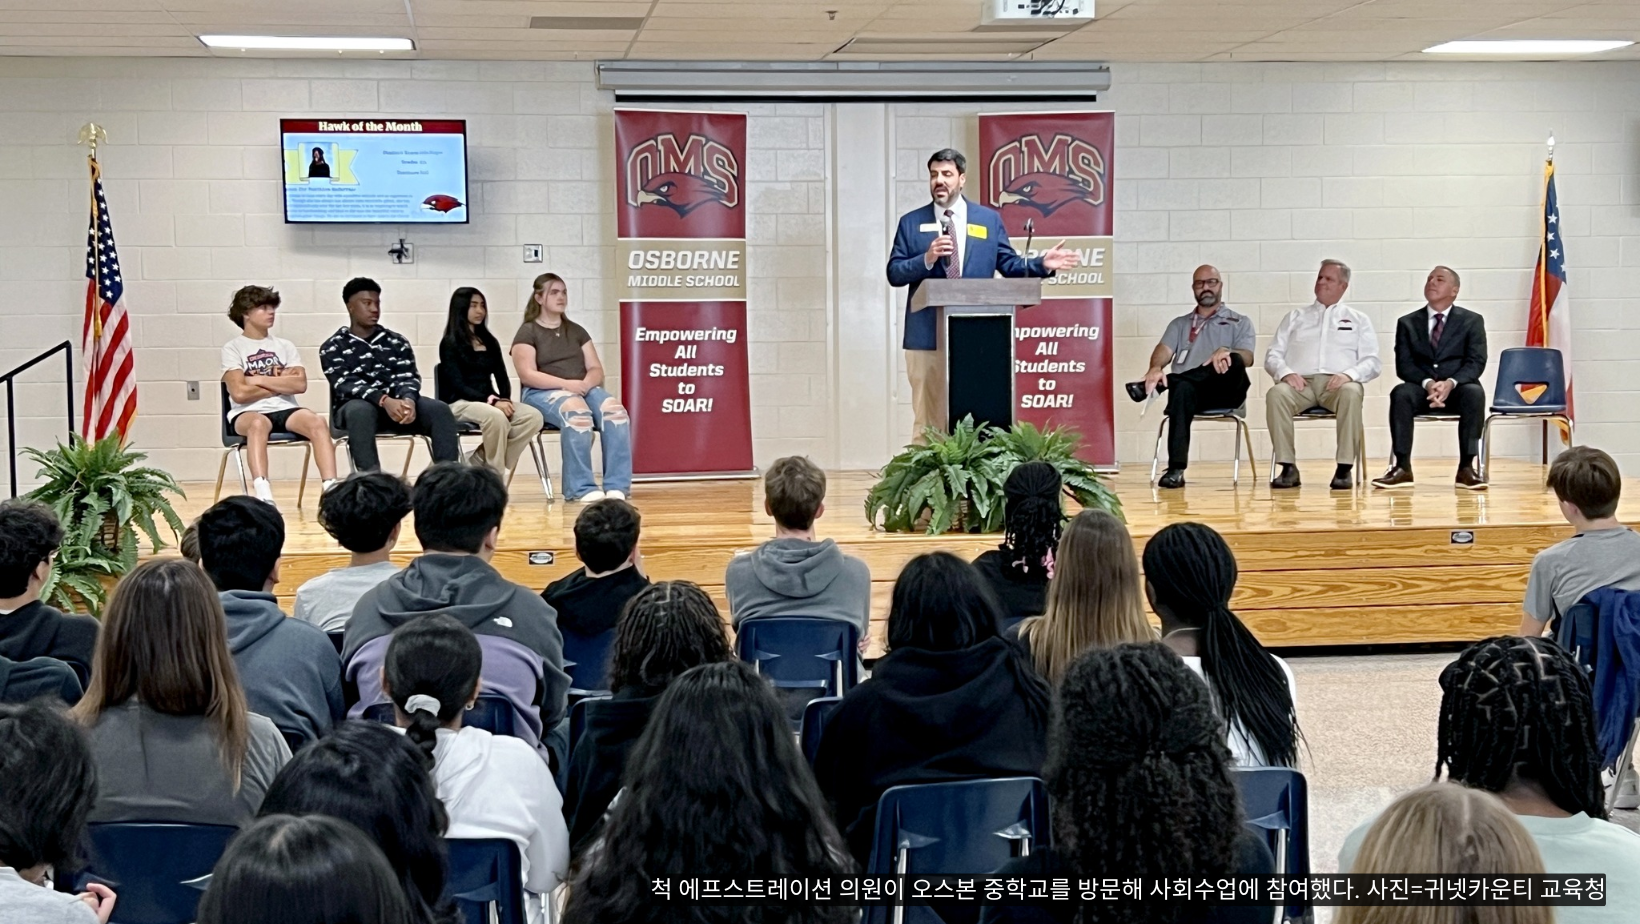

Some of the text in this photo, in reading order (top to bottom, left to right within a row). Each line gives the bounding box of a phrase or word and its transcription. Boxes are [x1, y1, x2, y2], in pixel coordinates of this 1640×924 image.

[318, 121, 423, 132] Hawk of the Month
[626, 133, 738, 208] OMS
[989, 133, 1105, 208] OMS
[628, 250, 740, 270] OSBORNE
[628, 275, 740, 287] MIDDLE SCHOOL
[635, 327, 737, 344] Empowering
[674, 345, 697, 359] All
[1035, 341, 1058, 356] All
[649, 363, 724, 377] Students
[678, 382, 695, 395] to
[1038, 378, 1056, 391] to
[661, 398, 713, 413] SOAR!
[1021, 394, 1074, 408] SOAR!
